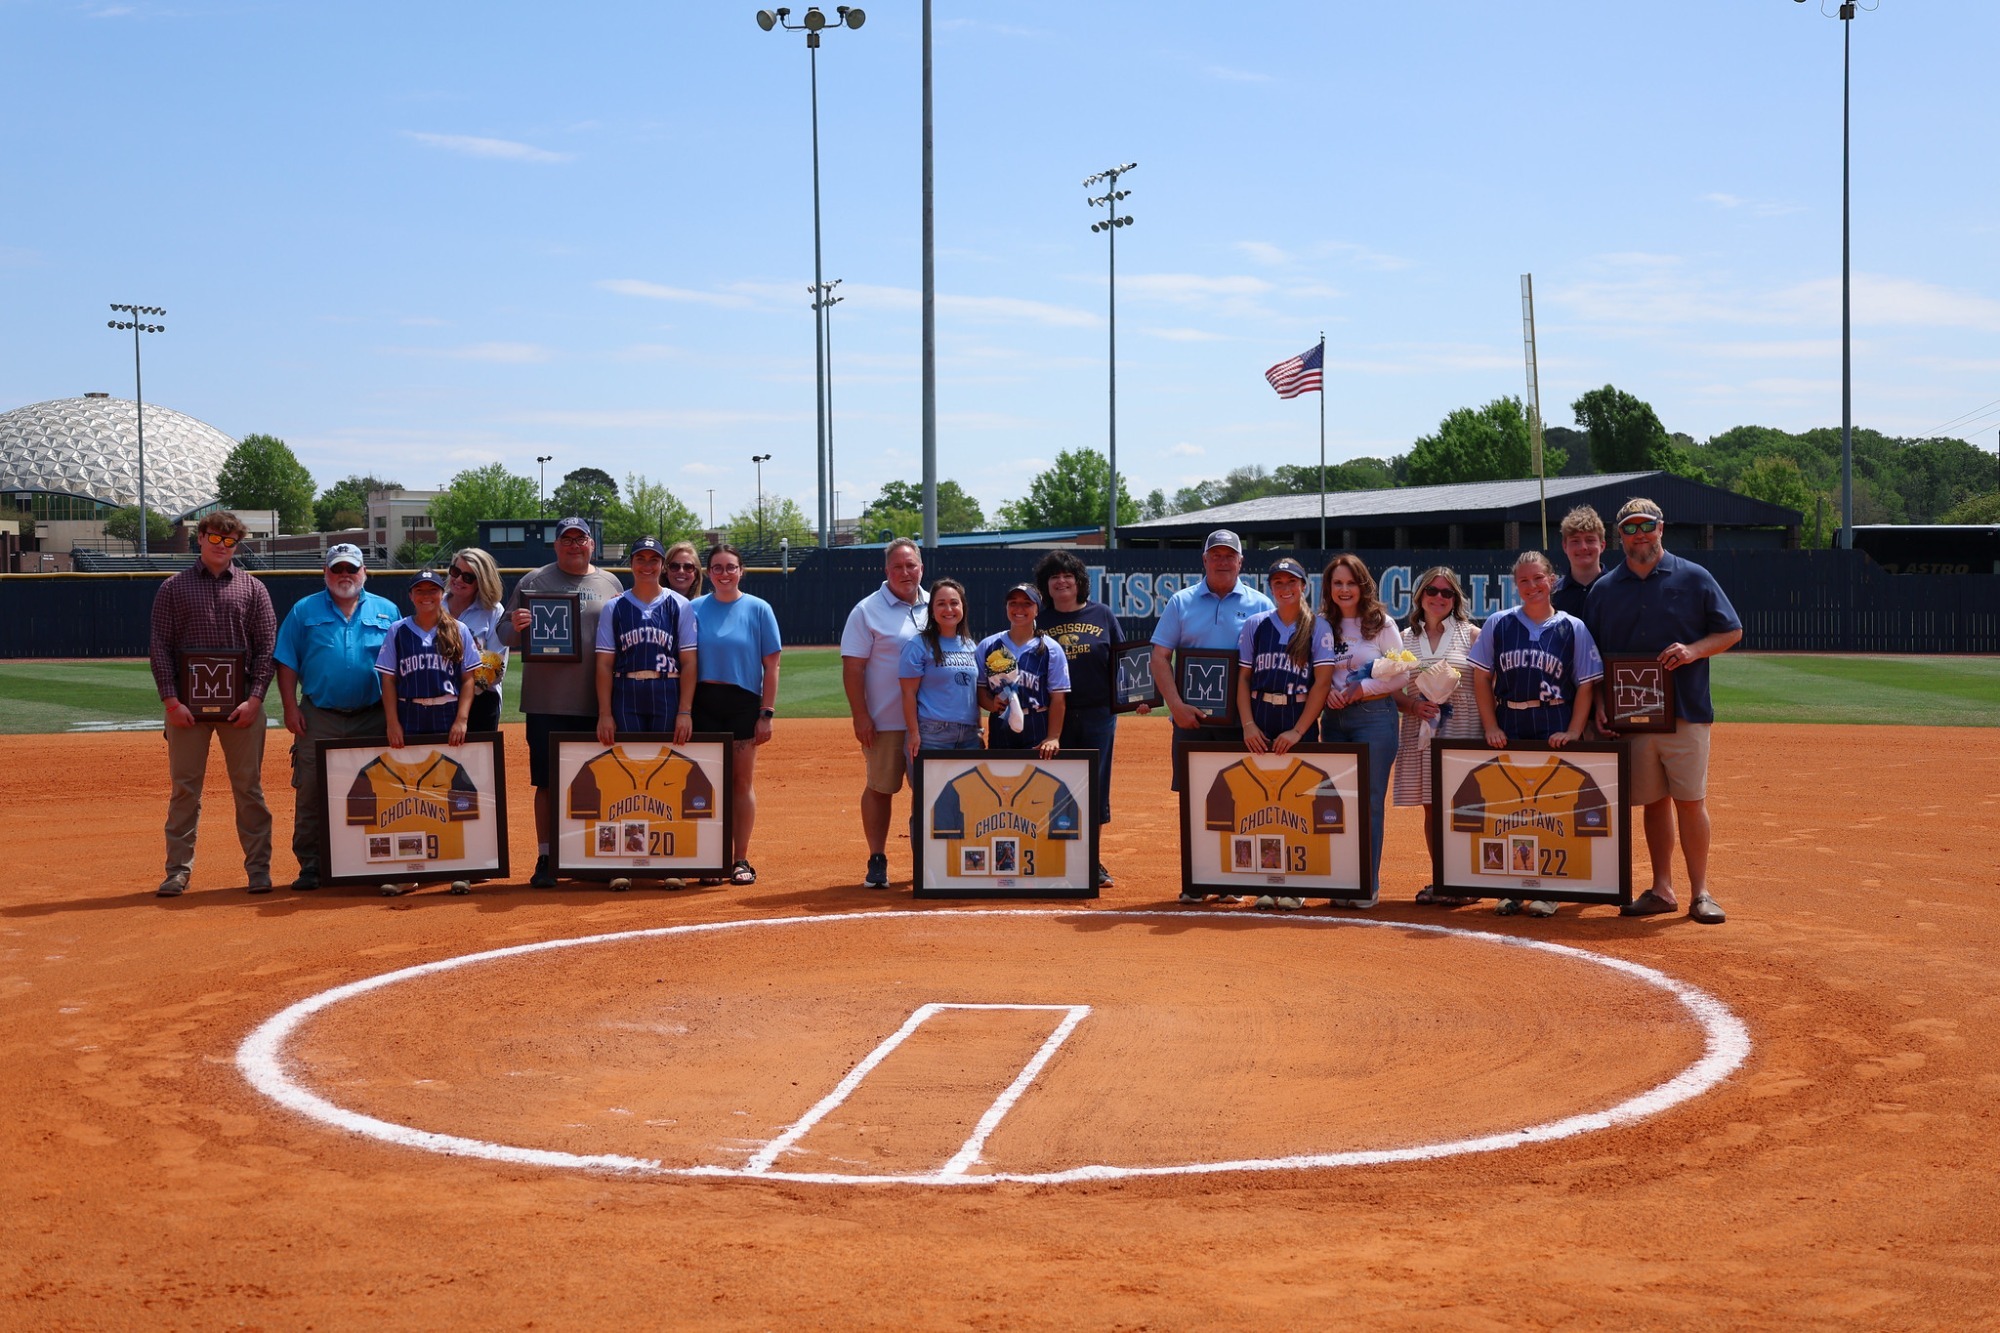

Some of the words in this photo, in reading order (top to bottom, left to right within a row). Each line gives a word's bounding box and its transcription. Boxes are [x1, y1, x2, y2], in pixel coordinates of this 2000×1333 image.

[1905, 563, 1970, 575] ASTRO
[531, 605, 569, 640] M
[619, 625, 674, 651] CHOCTAWS
[400, 653, 455, 677] CHOCTAWS
[1119, 652, 1152, 691] M
[1499, 649, 1564, 679] CHOCTAWS
[192, 664, 232, 698] M
[1186, 663, 1225, 701] M
[1617, 669, 1660, 707] M
[381, 797, 447, 828] CHOCTAWS
[607, 794, 673, 821] CHOCTAWS
[1240, 806, 1309, 835] CHOCTAWS
[975, 812, 1037, 839] CHOCTAWS
[1494, 808, 1565, 837] CHOCTAWS
[426, 834, 439, 859] 9
[649, 831, 675, 856] 20
[1023, 850, 1035, 876] 3
[1286, 845, 1307, 872] 13
[1540, 848, 1568, 877] 22
